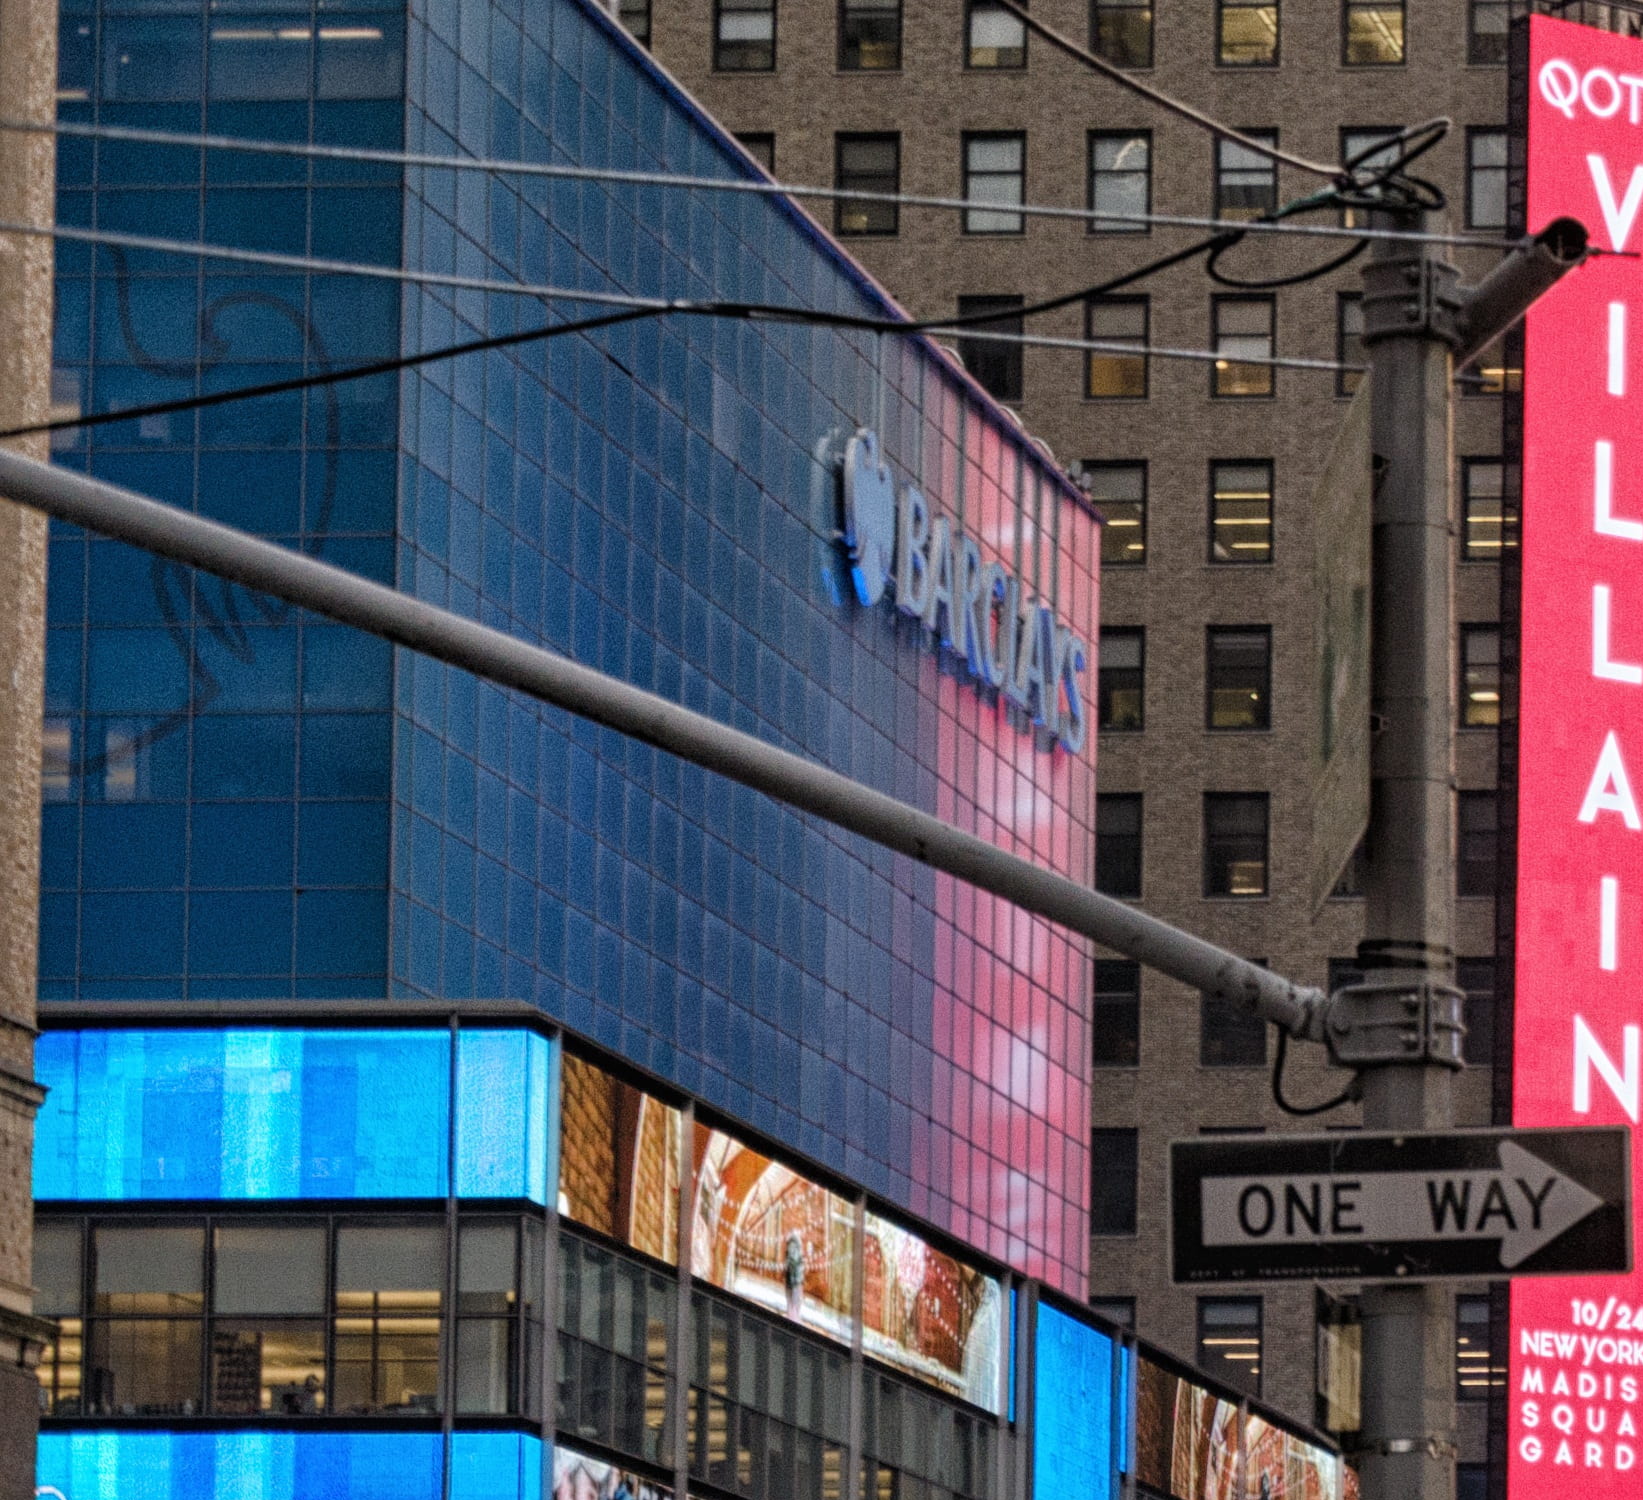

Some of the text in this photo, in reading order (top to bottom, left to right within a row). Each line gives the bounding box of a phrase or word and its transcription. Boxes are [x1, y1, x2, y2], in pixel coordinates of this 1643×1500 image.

[896, 485, 1086, 753] BARCLAYS
[1237, 1176, 1557, 1238] ONE WAY
[1520, 1330, 1578, 1359] NEW
